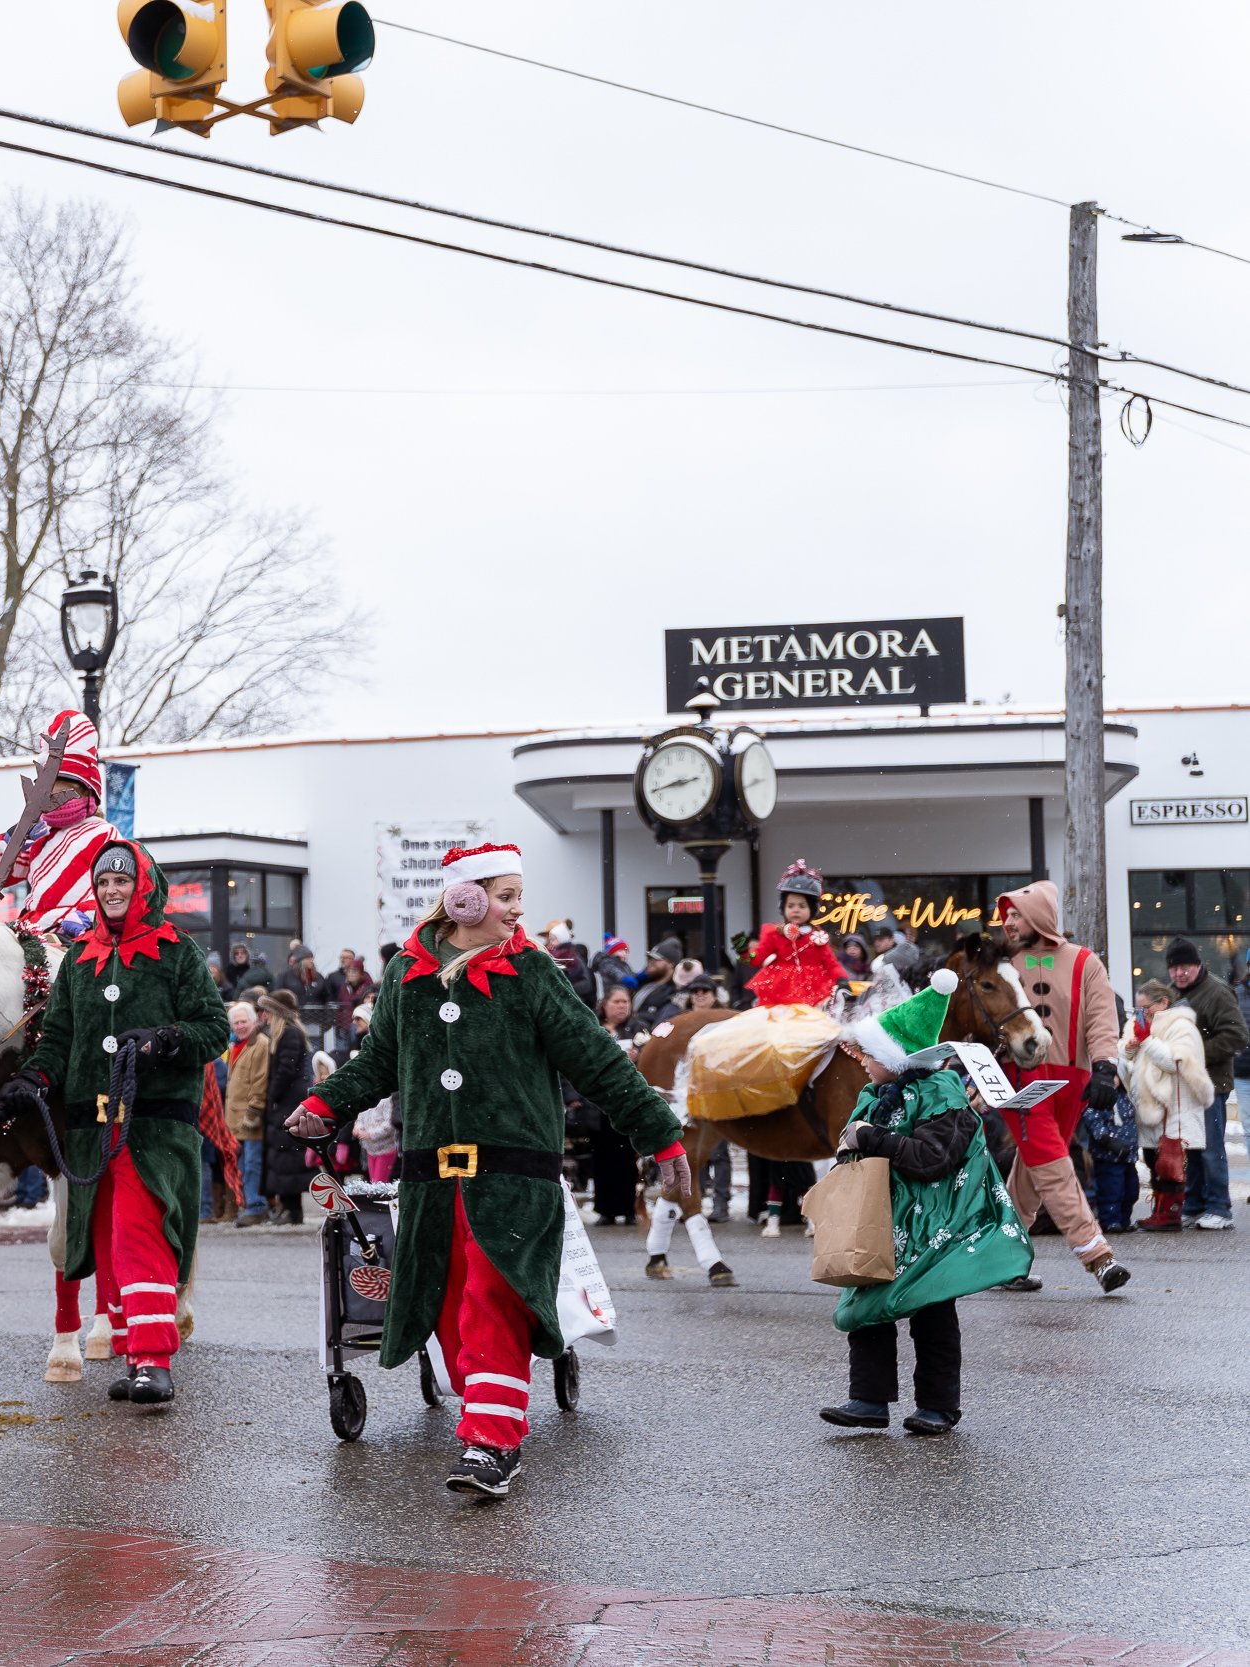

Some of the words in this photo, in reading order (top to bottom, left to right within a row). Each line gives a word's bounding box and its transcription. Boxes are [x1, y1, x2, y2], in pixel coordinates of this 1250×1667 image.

[689, 628, 940, 666] METAMORA
[713, 666, 916, 701] GENERAL
[1136, 802, 1243, 819] ESPRESSO
[401, 840, 430, 851] One
[910, 896, 981, 928] Wine
[970, 1058, 1009, 1102] HEY
